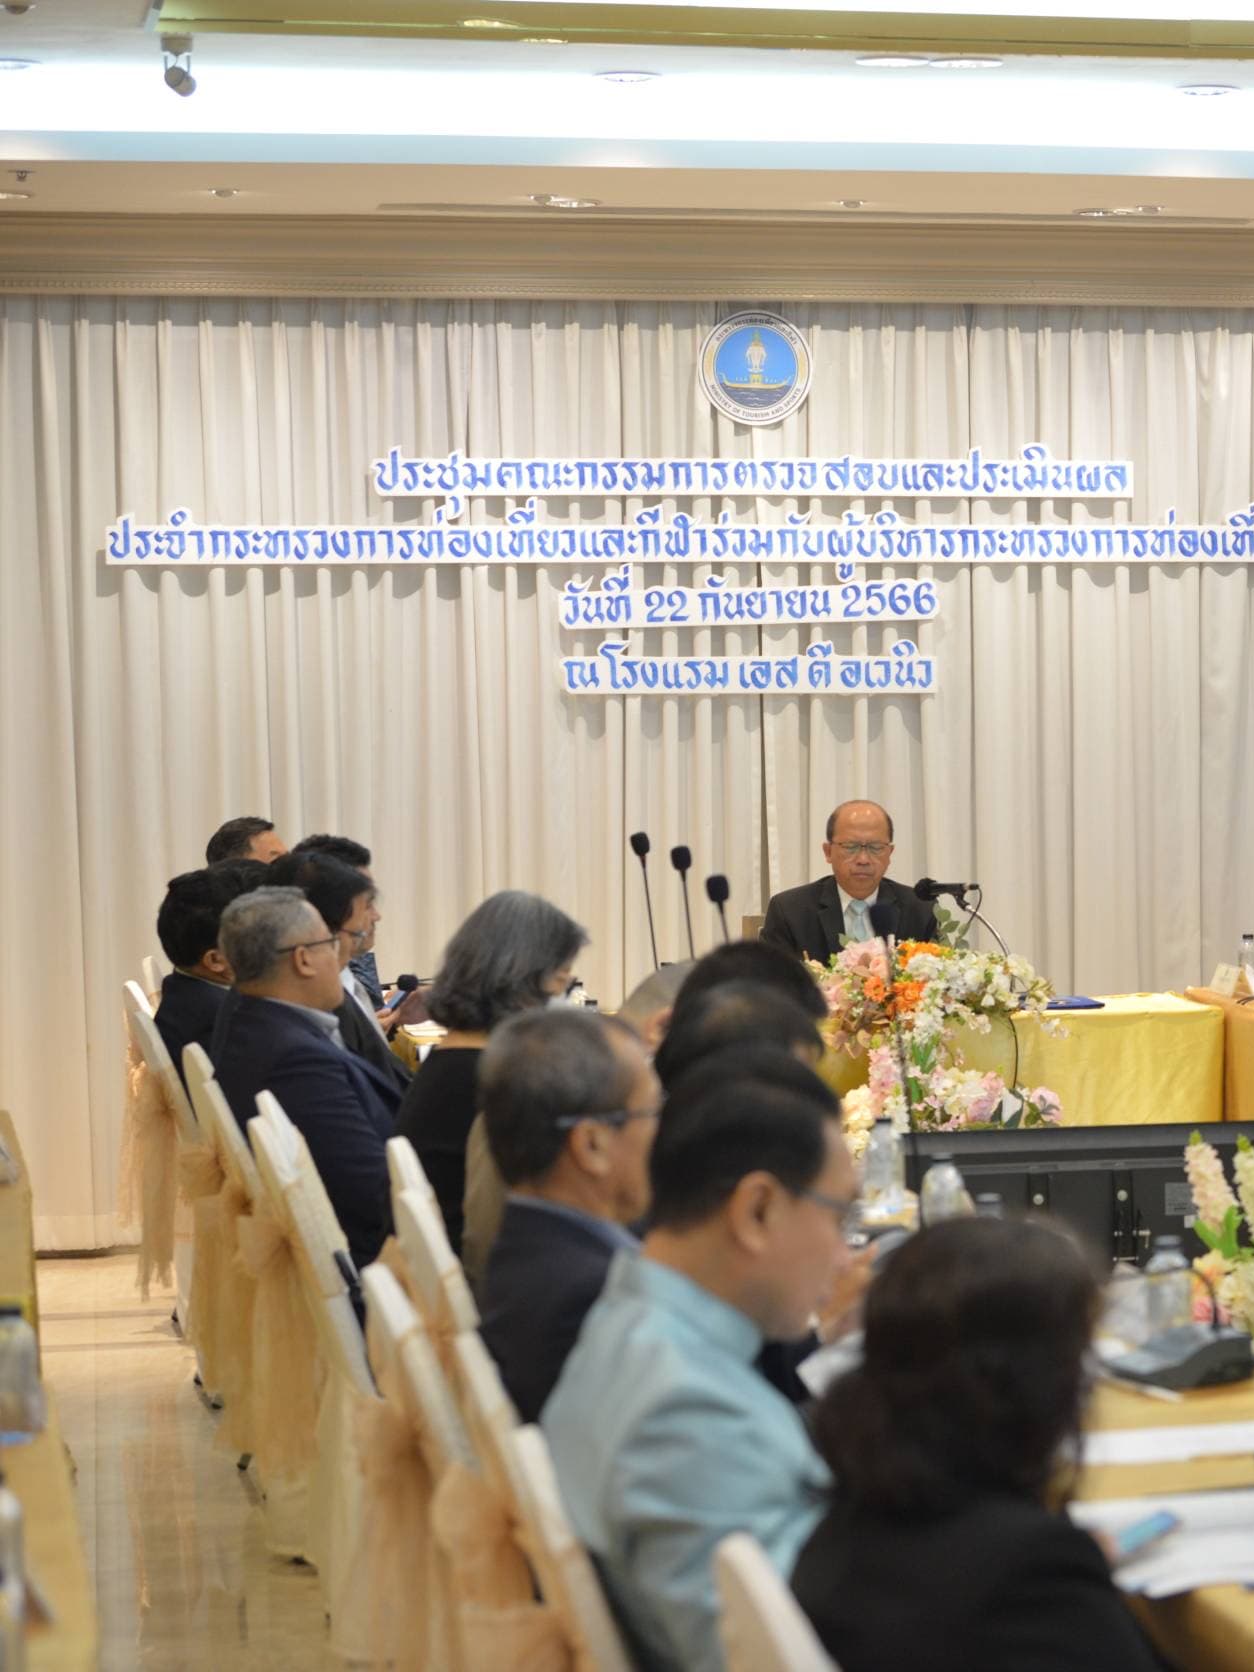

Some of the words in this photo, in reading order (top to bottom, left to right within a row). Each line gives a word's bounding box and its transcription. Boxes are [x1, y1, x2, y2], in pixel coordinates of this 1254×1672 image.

[564, 564, 632, 625] วันที่
[644, 589, 689, 622] 22
[698, 576, 832, 622] กันยายน
[840, 583, 937, 617] 2566
